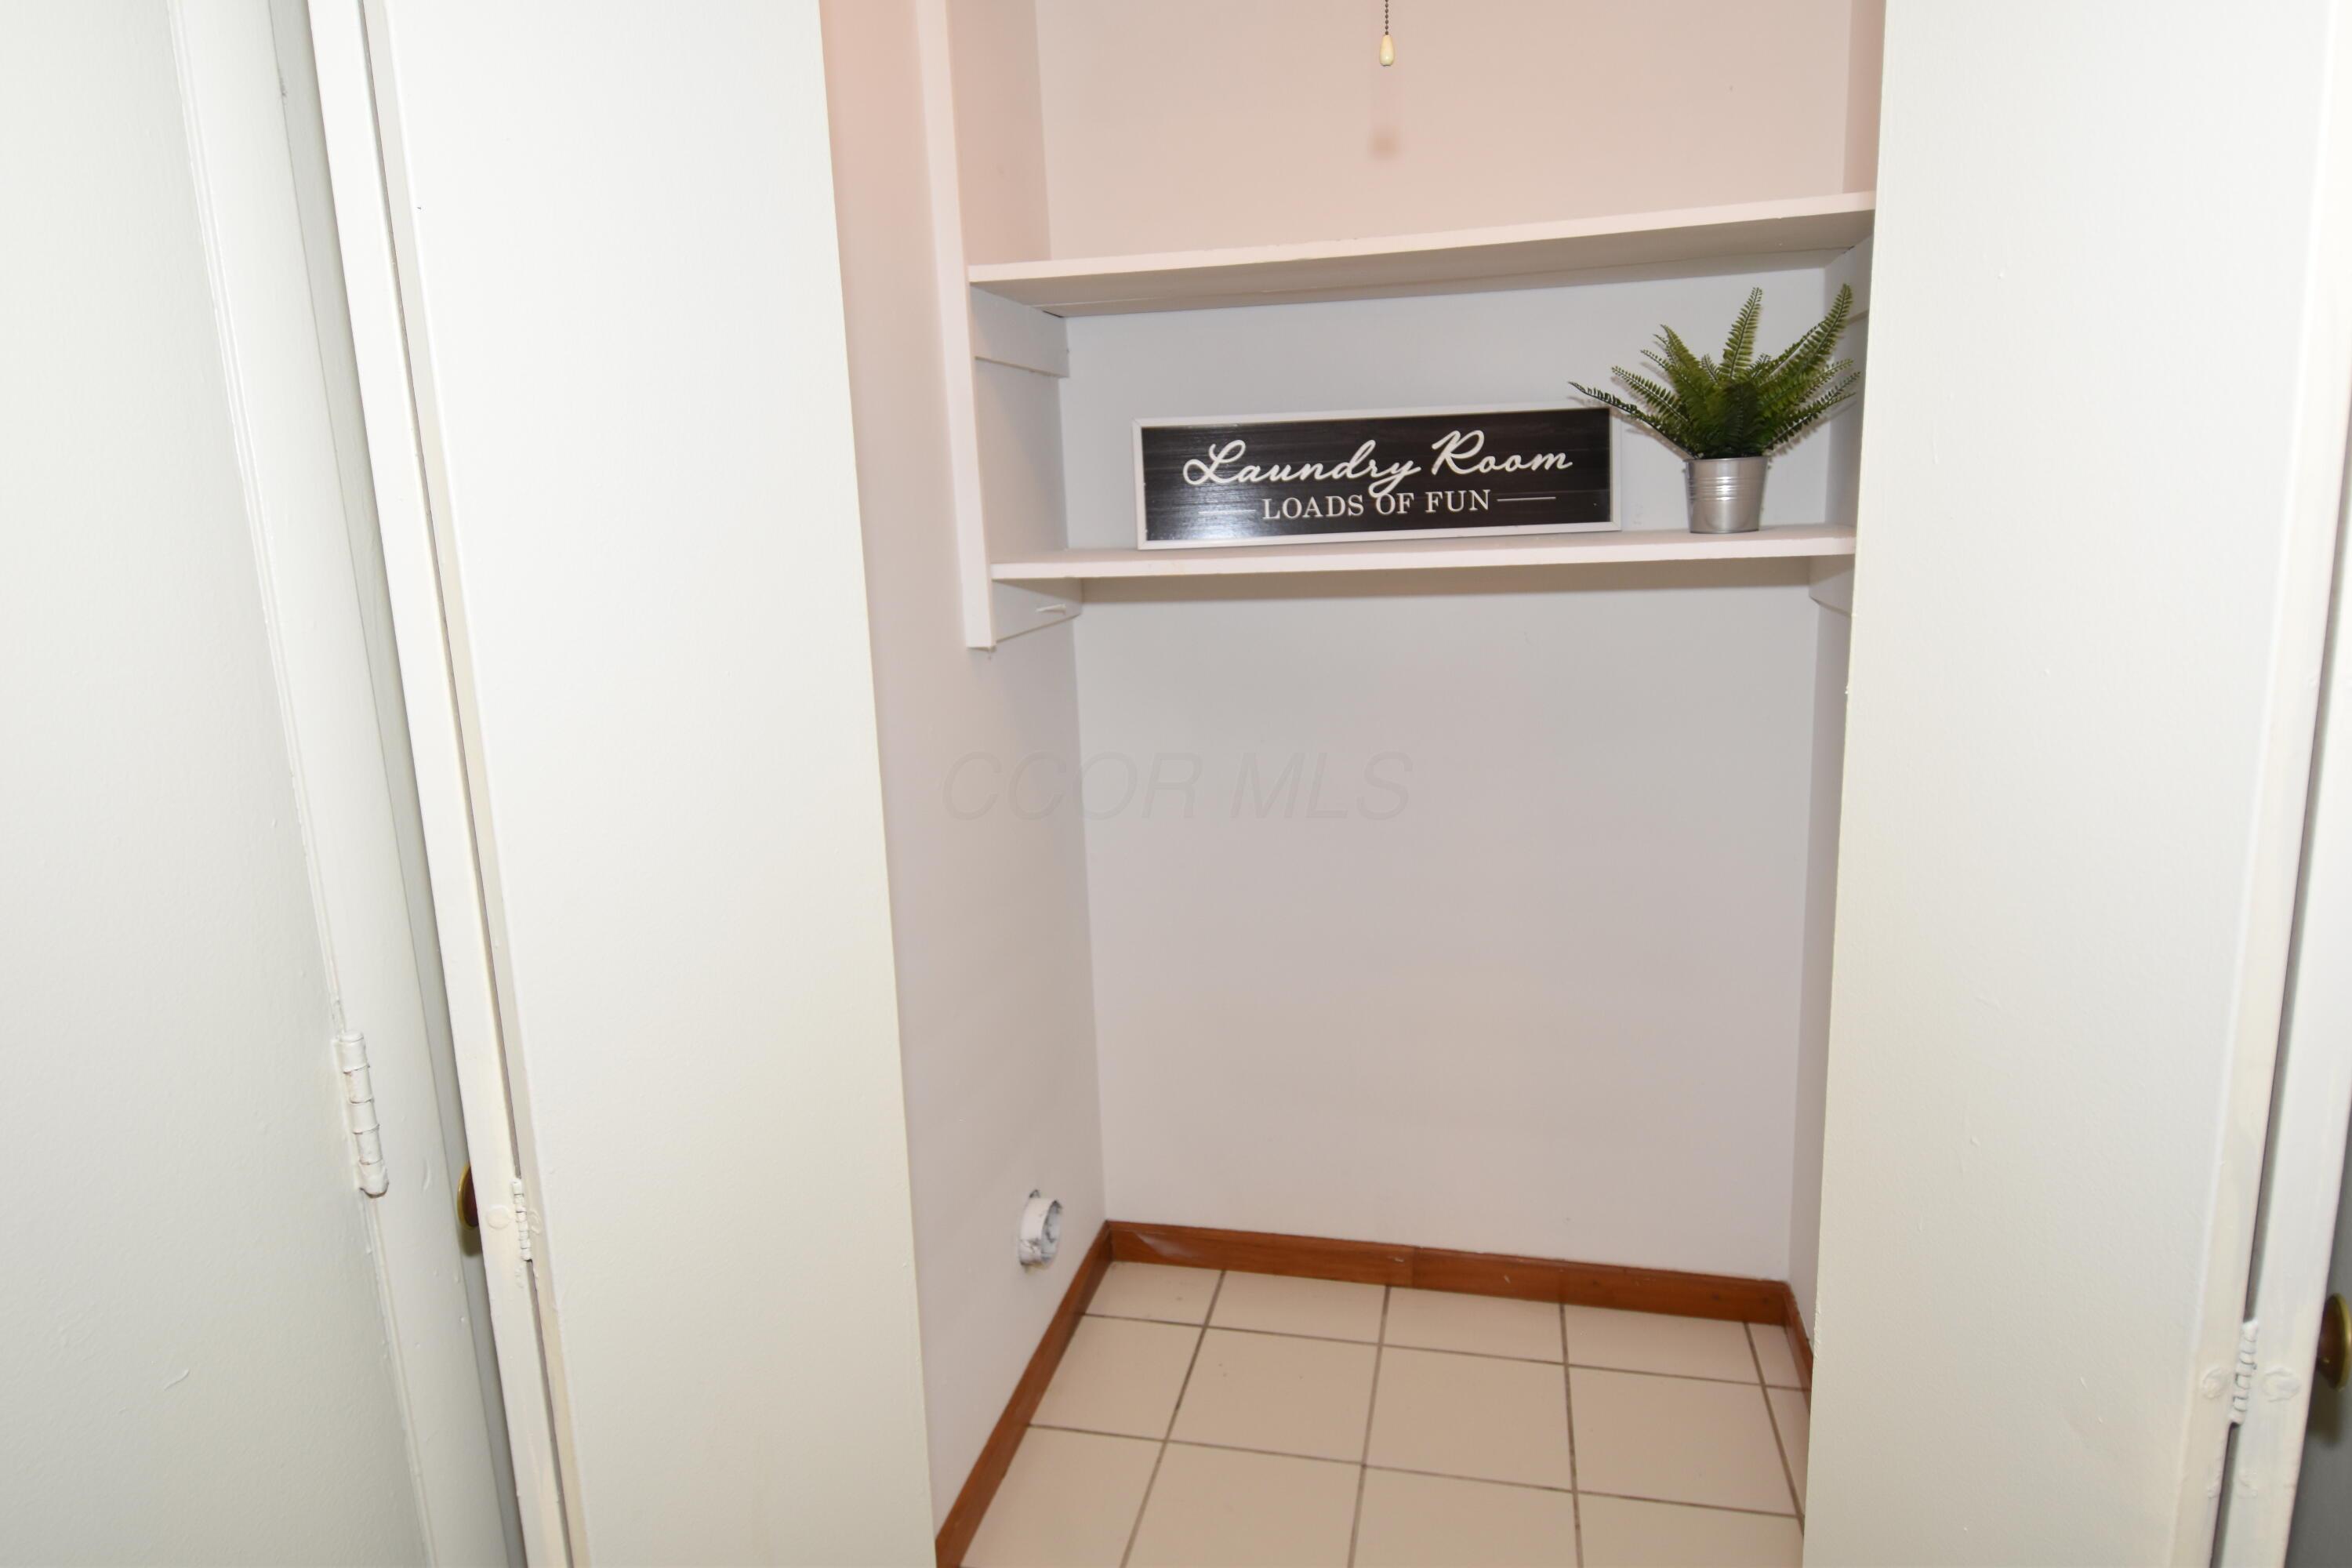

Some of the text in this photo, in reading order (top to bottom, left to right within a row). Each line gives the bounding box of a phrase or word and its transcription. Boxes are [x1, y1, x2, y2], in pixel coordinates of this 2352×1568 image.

[1183, 430, 1573, 498] Laundry Room
[1262, 489, 1490, 520] LOADS OF FUN
